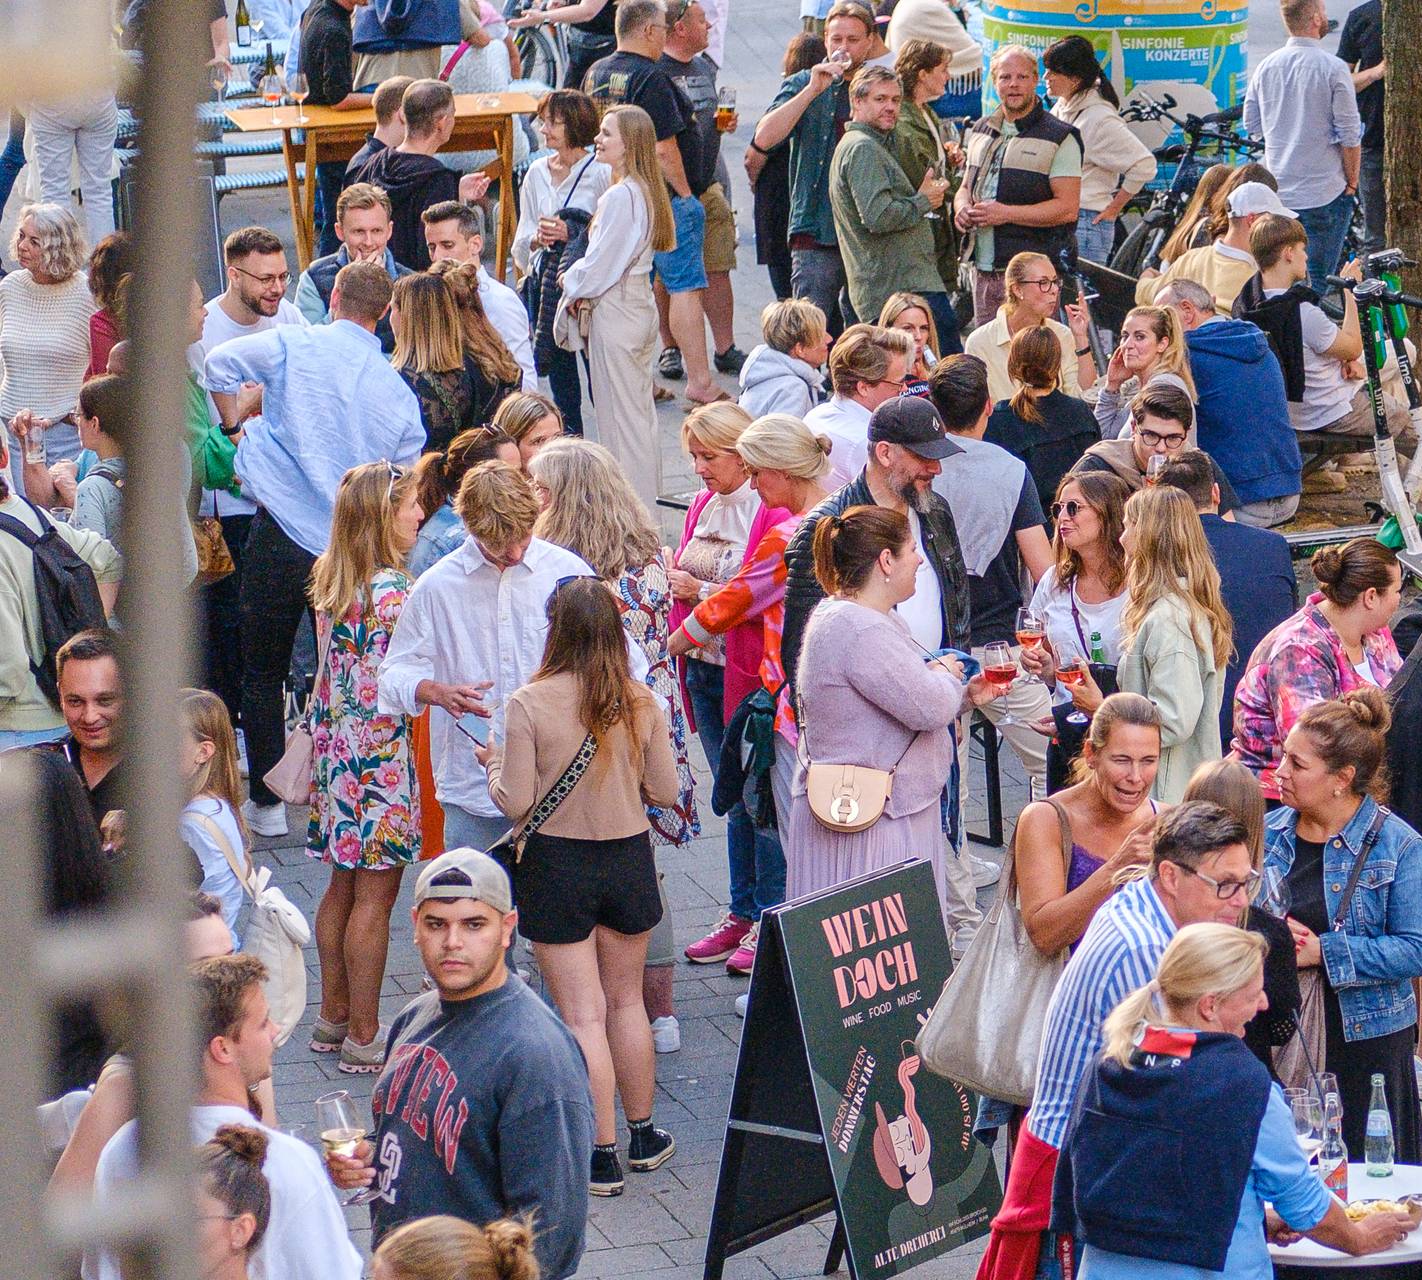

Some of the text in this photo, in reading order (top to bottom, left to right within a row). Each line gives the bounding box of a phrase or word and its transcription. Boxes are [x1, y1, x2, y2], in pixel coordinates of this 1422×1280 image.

[1122, 37, 1184, 49] SINFONIE
[1145, 48, 1209, 62] KONZERTE
[1397, 354, 1412, 385] lime
[821, 893, 909, 958] WEIN
[833, 941, 919, 1009] DOCH
[842, 989, 923, 1029] WINE FOOD MUSIC
[832, 1045, 868, 1144] JEDEN VIERTEN
[838, 1055, 877, 1154] DONNERSTAG
[874, 1246, 900, 1269] ALTE
